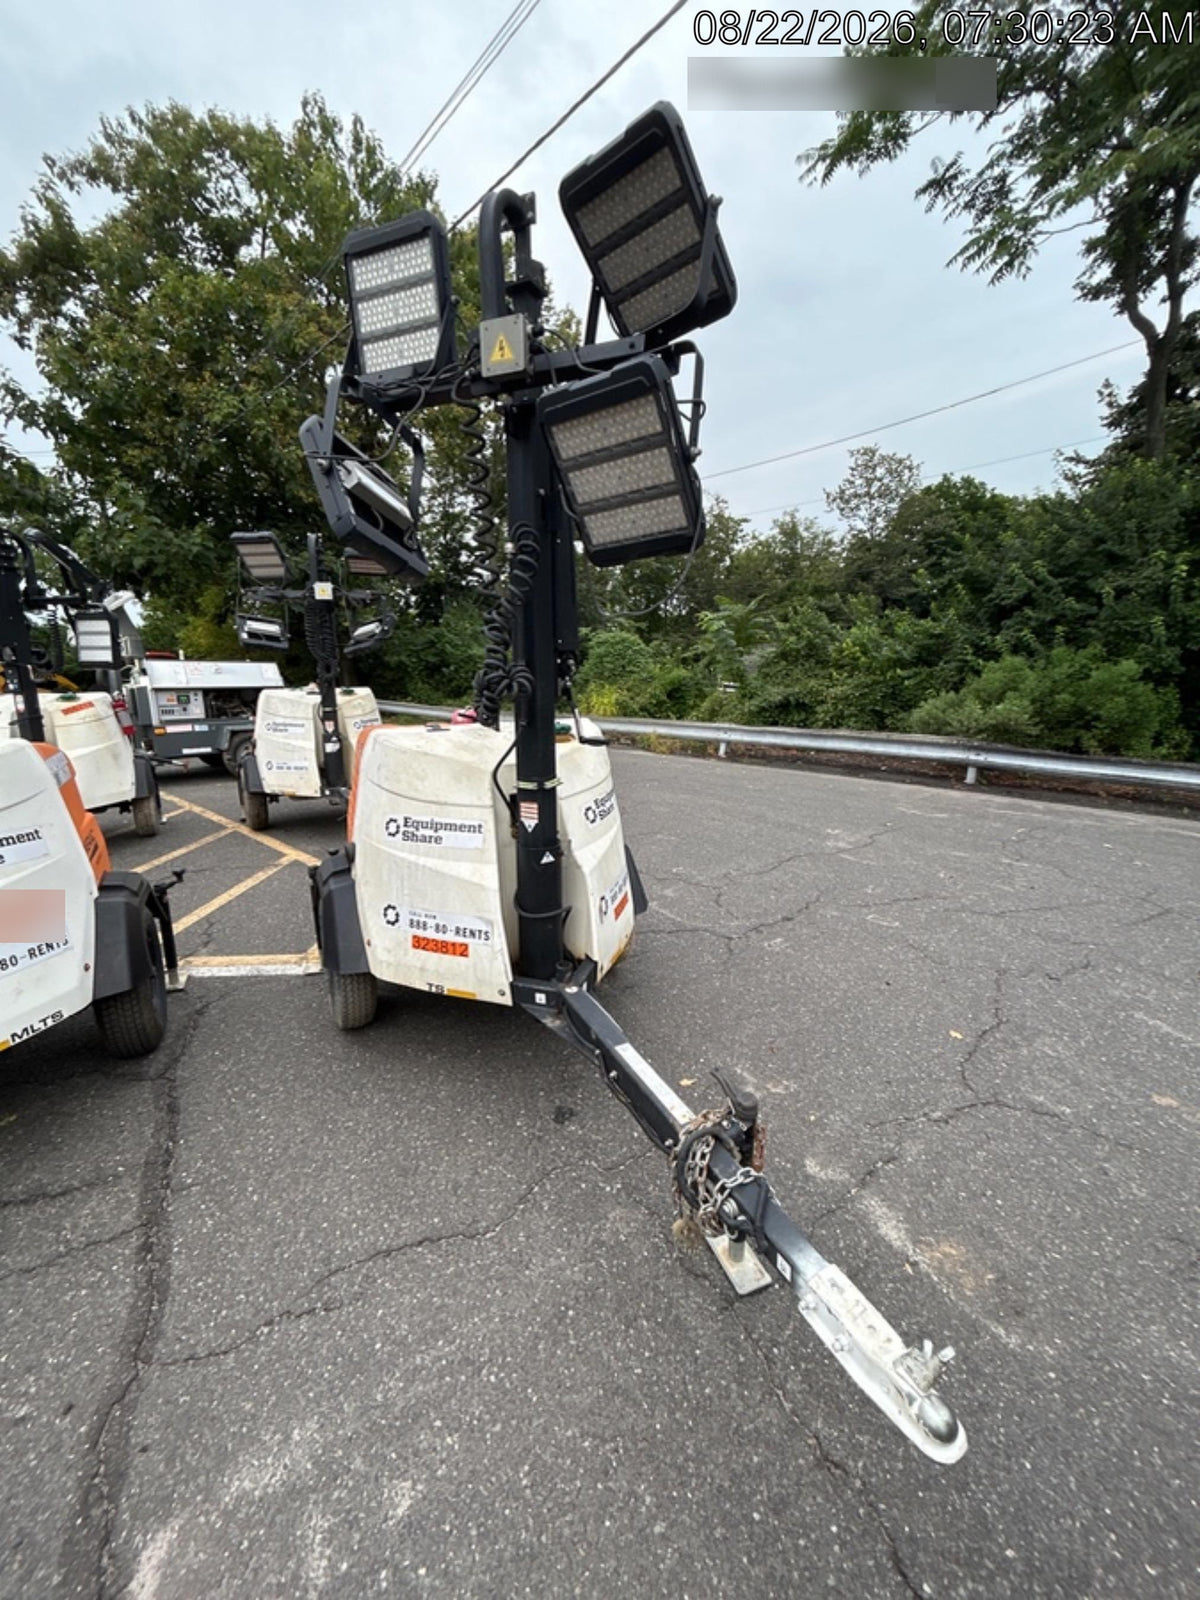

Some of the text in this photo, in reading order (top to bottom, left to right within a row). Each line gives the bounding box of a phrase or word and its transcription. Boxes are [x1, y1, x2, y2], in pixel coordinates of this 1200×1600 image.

[402, 816, 484, 834] Equipment
[401, 830, 443, 845] Share
[408, 918, 491, 941] 888-80-RENTS
[10, 1009, 64, 1043] MLTS
